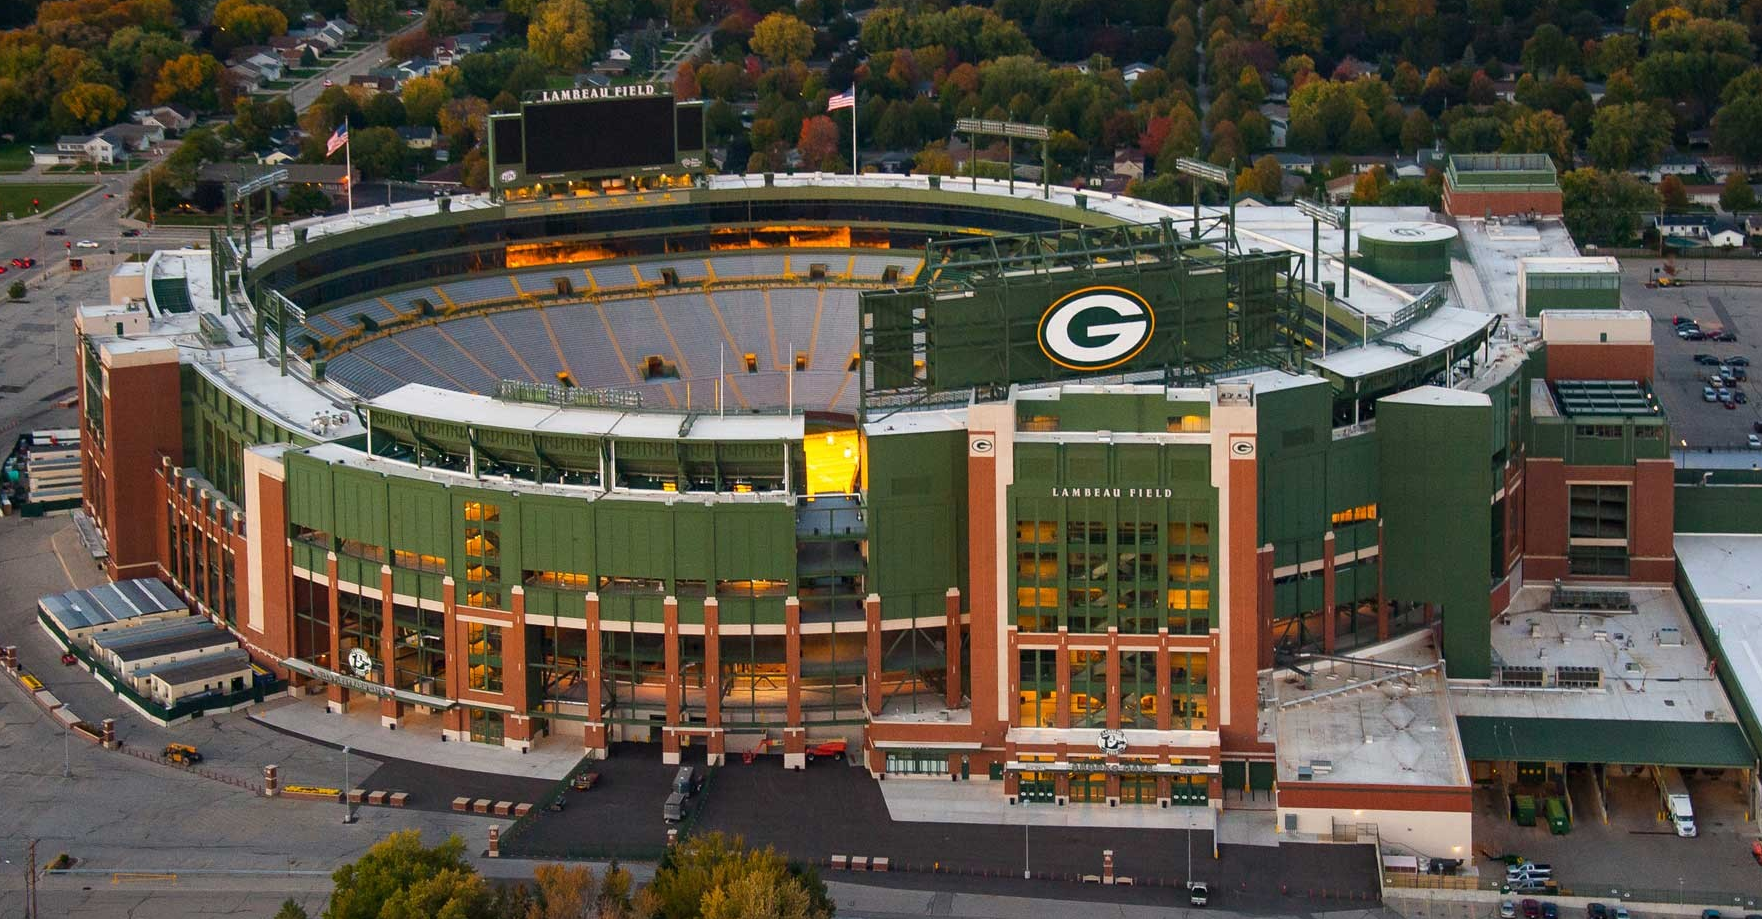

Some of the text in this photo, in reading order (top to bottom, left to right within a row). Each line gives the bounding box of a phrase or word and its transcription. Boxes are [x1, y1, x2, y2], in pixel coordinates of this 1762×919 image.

[542, 84, 654, 102] LAMBEAU FIELD
[1045, 293, 1147, 362] G
[1052, 487, 1172, 498] LAMBEAU FIELD
